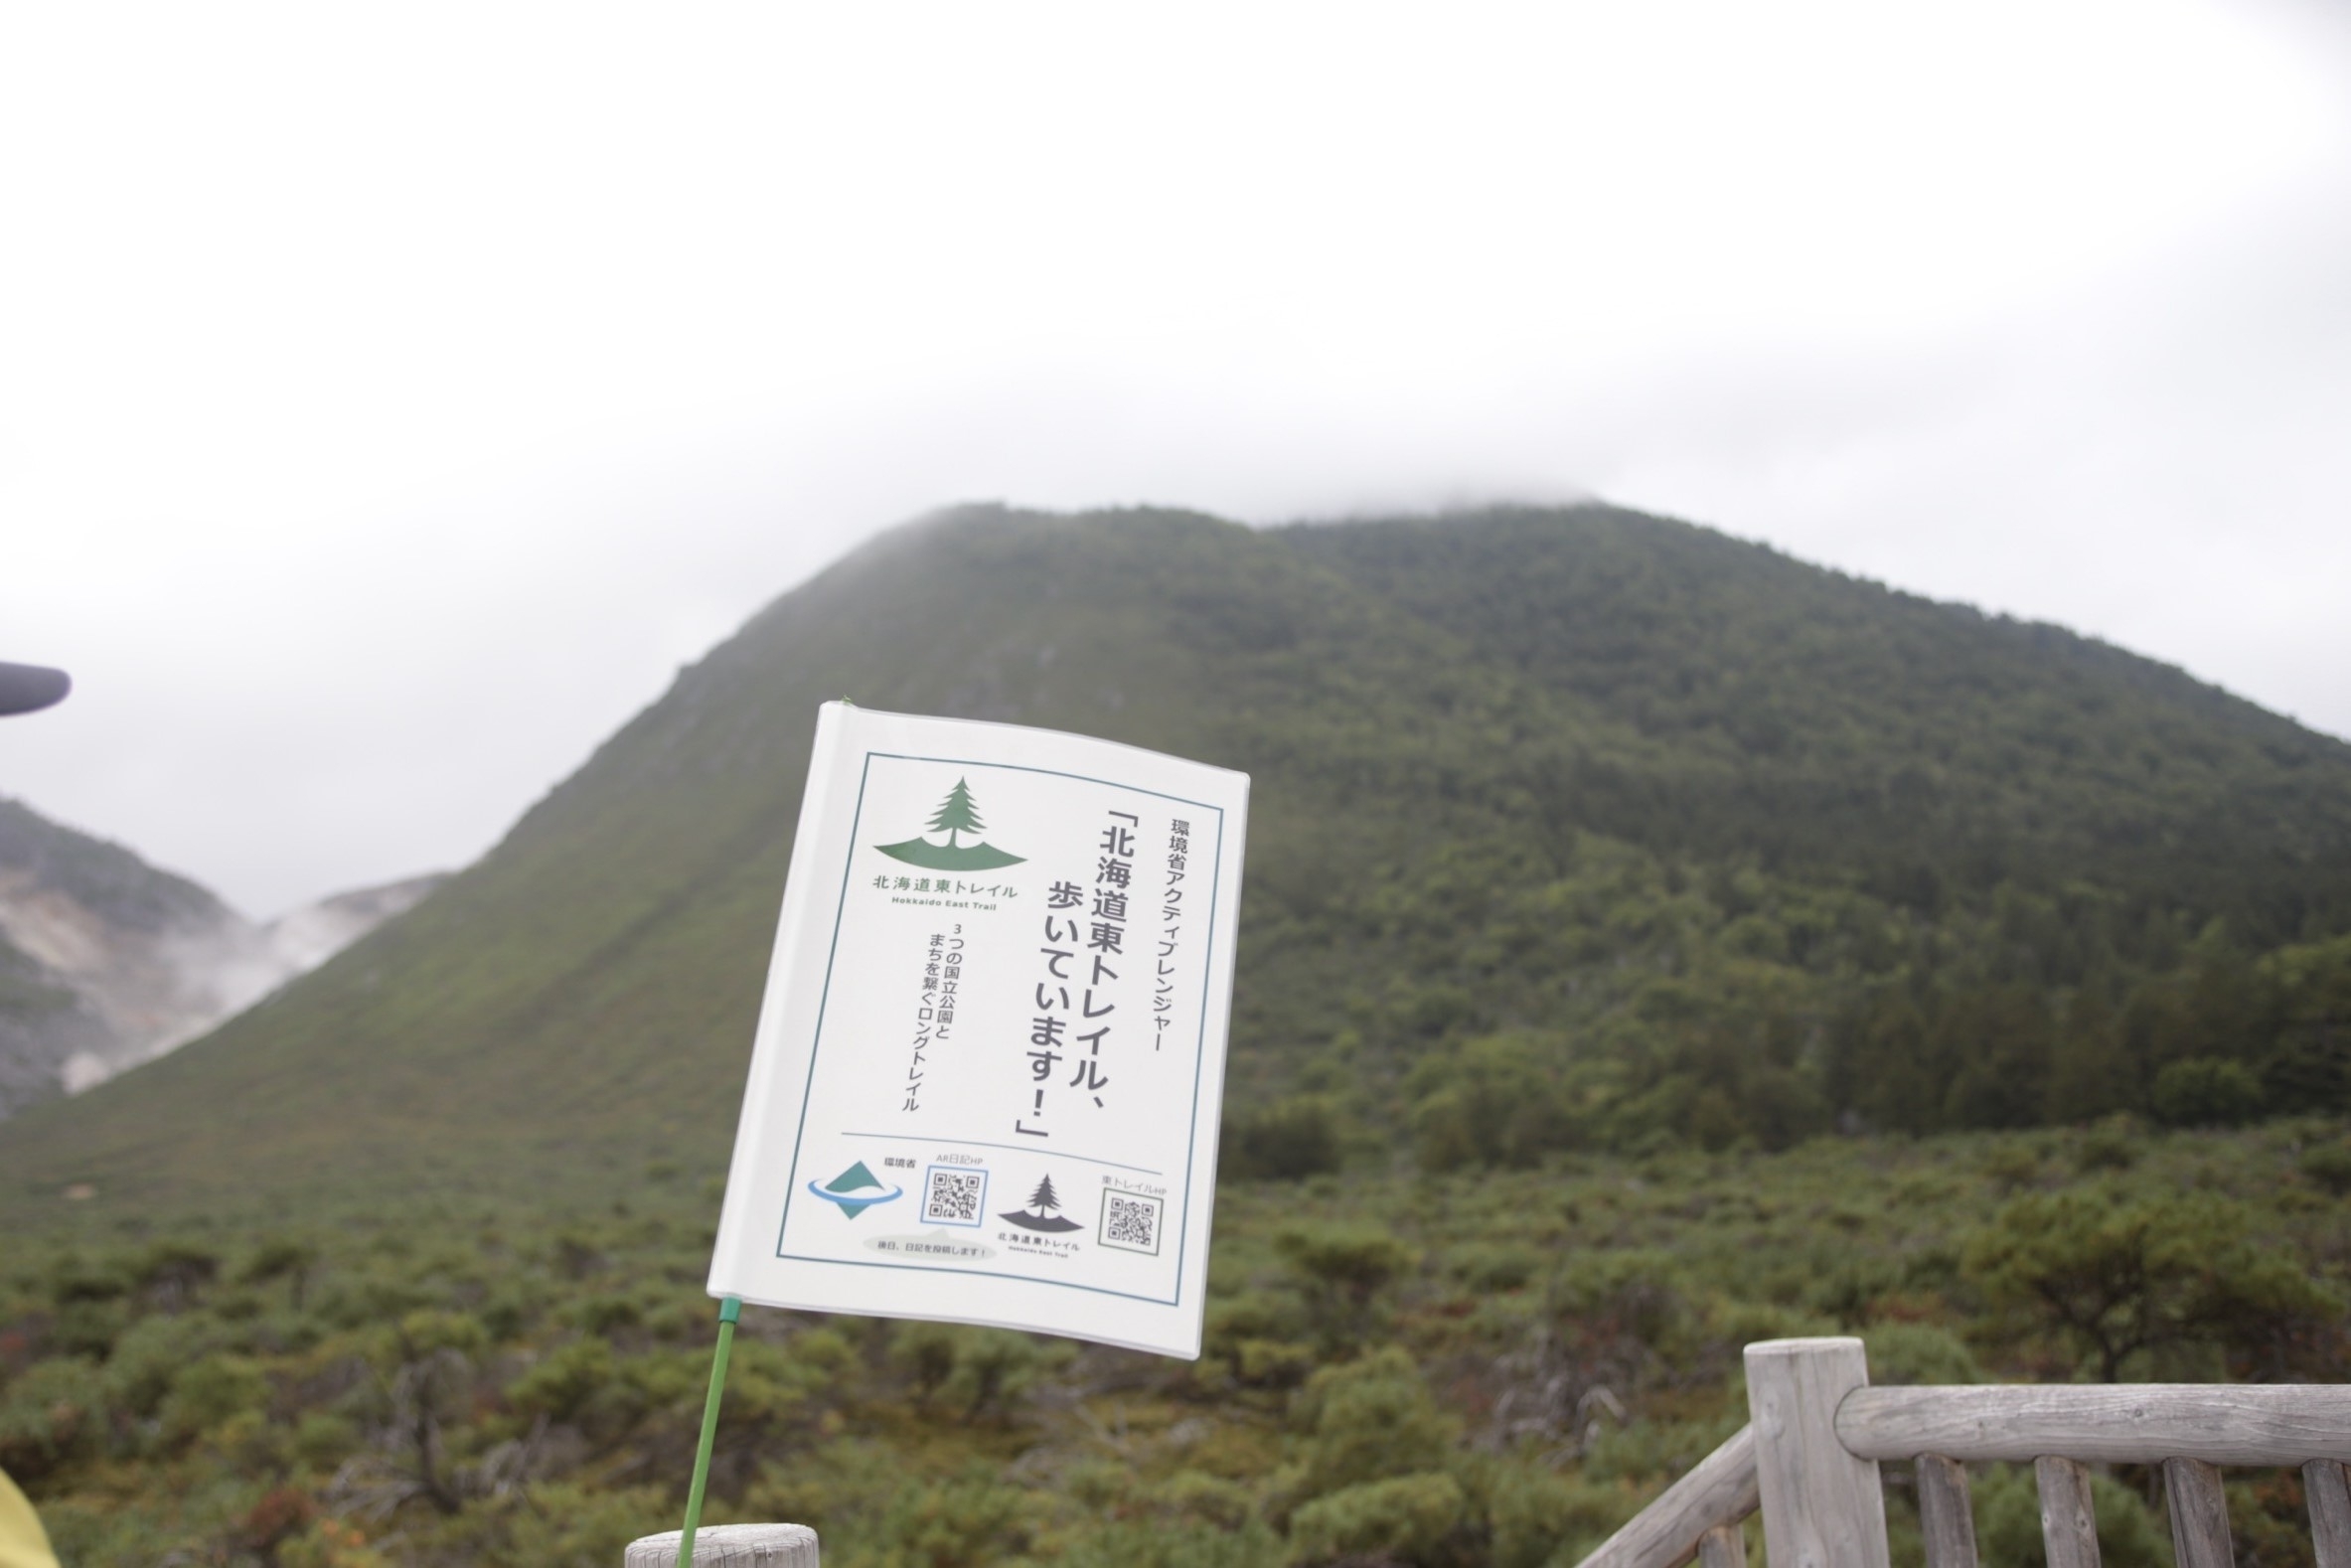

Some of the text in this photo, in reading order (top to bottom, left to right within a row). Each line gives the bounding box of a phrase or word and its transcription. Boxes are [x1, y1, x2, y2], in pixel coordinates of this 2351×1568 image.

[872, 874, 1019, 898] 北海道東トレイル
[892, 896, 997, 911] Hokkaido East Trail
[1069, 810, 1139, 1108] 「北海道東トレイル、
[1153, 818, 1189, 1051] 環境省アクティブレンジャー
[935, 923, 964, 1039] 3つの国立公園と
[1016, 880, 1083, 1138] 歩いています！」
[901, 933, 945, 1112] まちを繋ぐロングトレイル
[884, 1157, 916, 1169] 環境省
[936, 1154, 984, 1166] AR日記HP
[998, 1231, 1080, 1252] 北海道東トレイル
